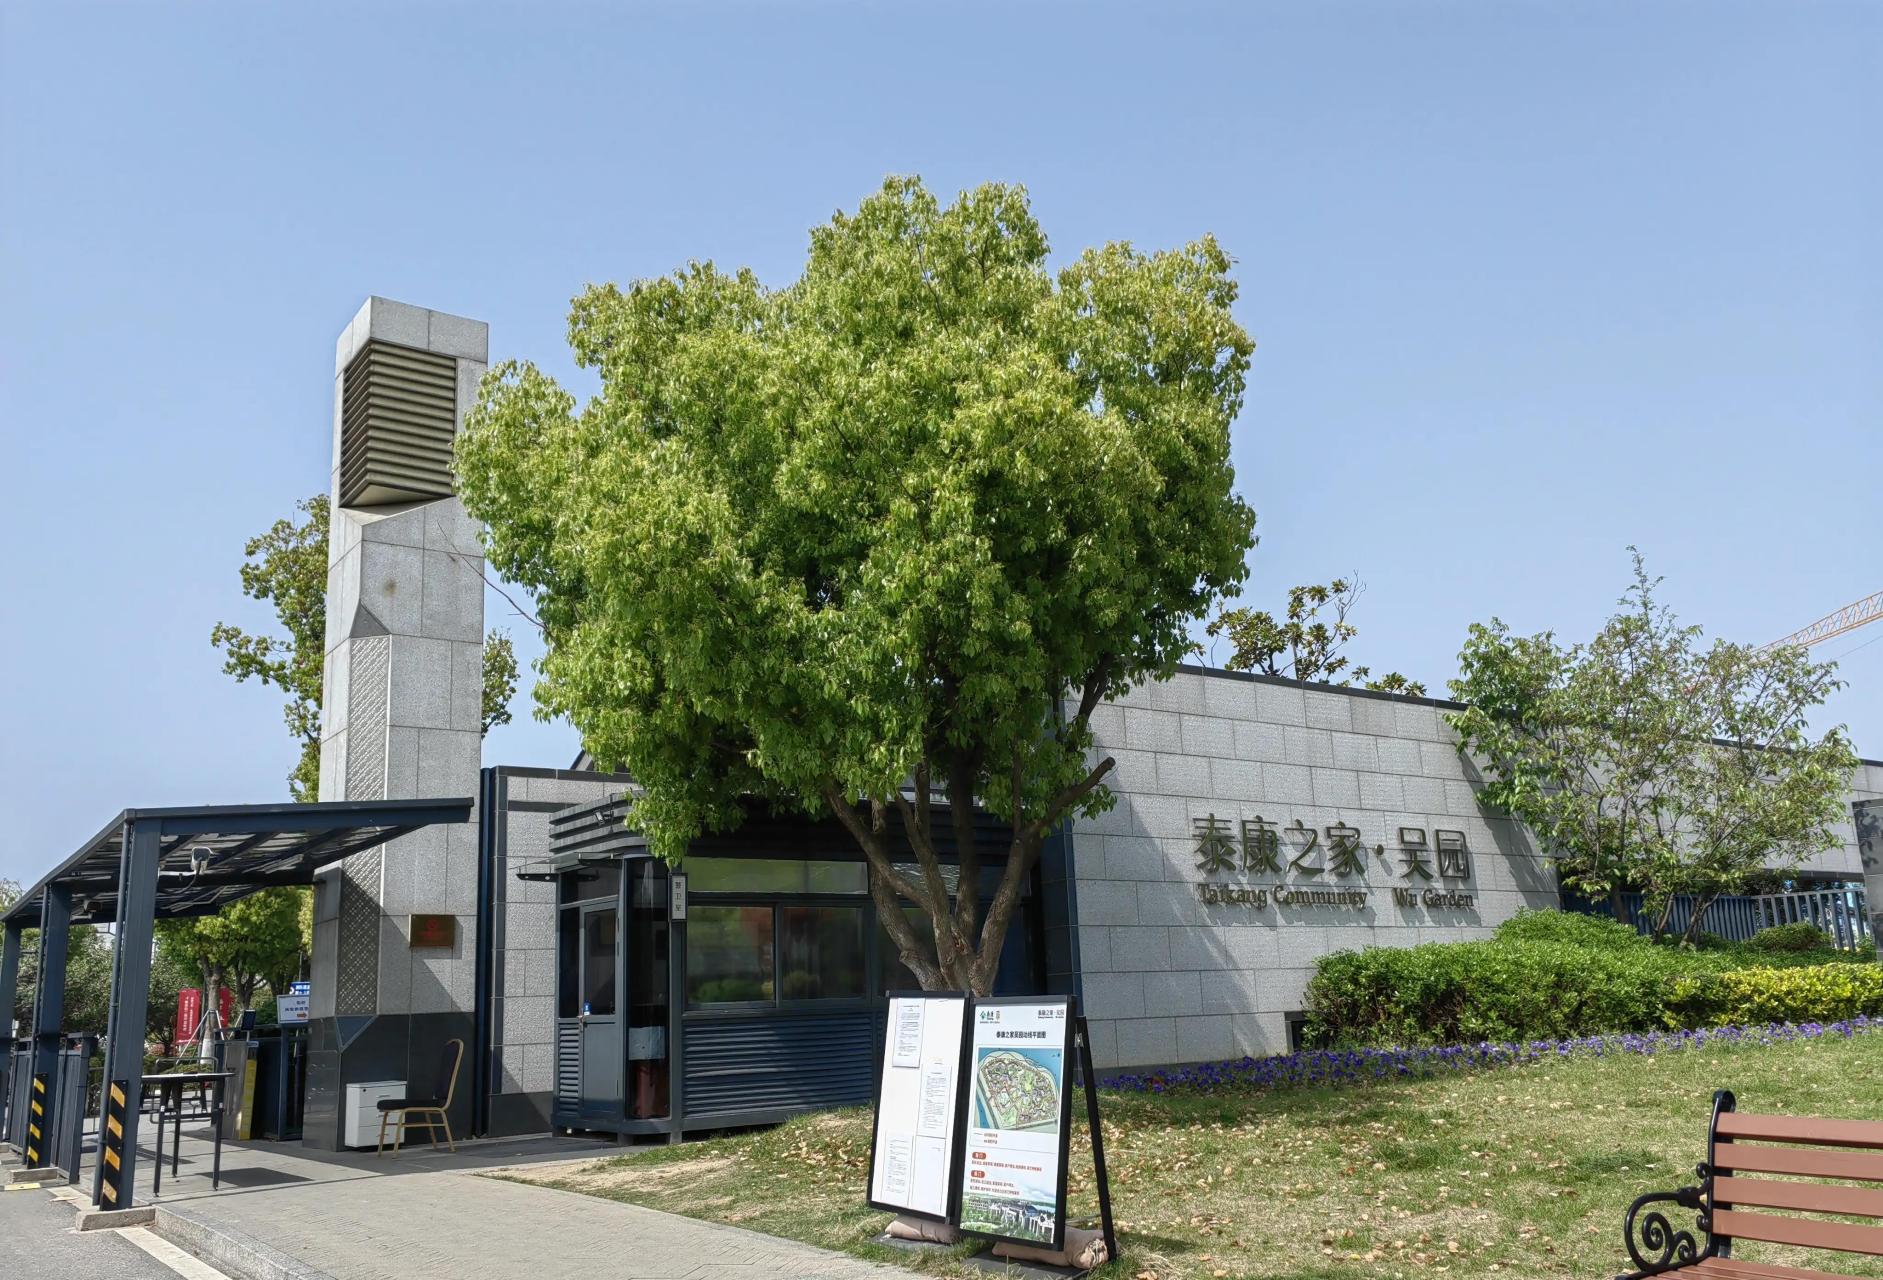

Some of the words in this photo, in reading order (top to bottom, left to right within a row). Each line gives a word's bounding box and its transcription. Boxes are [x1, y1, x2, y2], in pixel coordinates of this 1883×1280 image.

[1192, 813, 1470, 880] 泰康之家·吴园
[1198, 884, 1268, 909] Taikang
[1273, 885, 1367, 911] Community
[1393, 887, 1418, 907] Wu
[1423, 888, 1474, 908] Garden
